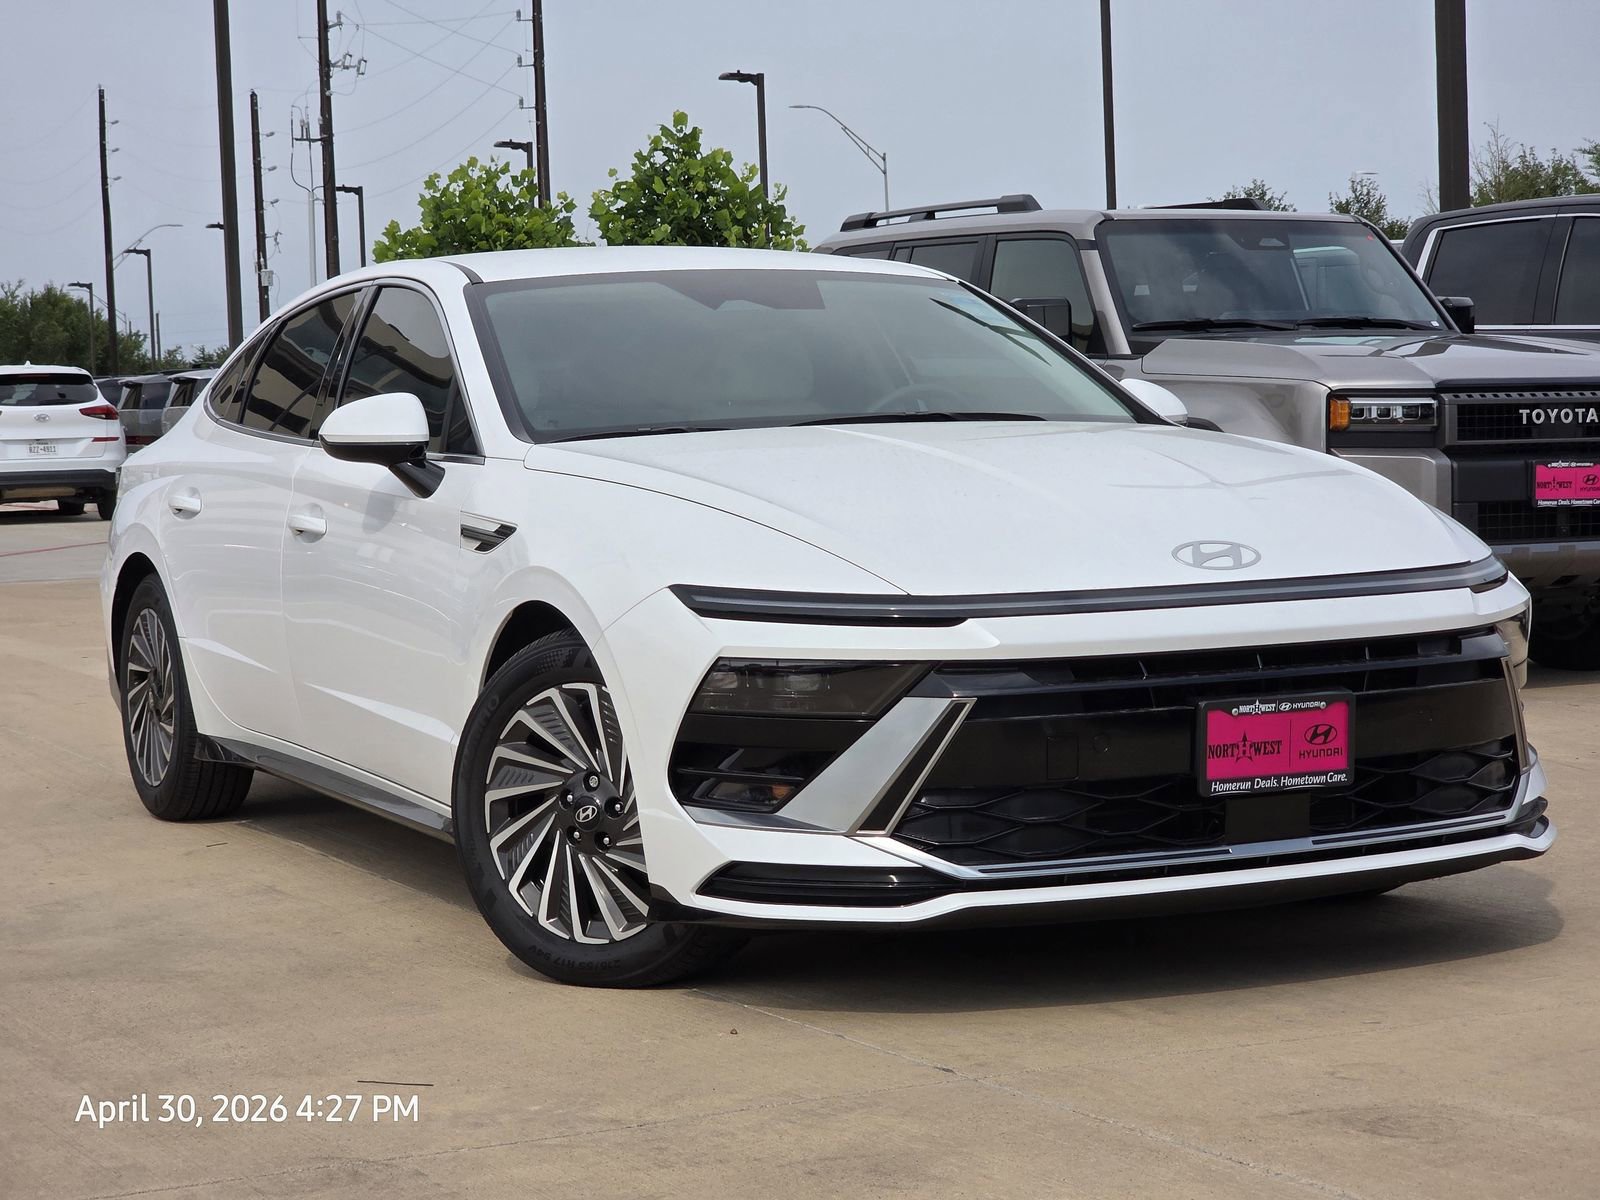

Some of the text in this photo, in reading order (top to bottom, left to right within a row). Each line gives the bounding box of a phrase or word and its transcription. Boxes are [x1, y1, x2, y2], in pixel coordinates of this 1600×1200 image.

[1519, 407, 1599, 425] TOYOTA
[1299, 747, 1343, 760] HYUNDAI
[1211, 772, 1348, 793] Homerun Deals. Hometown Care.
